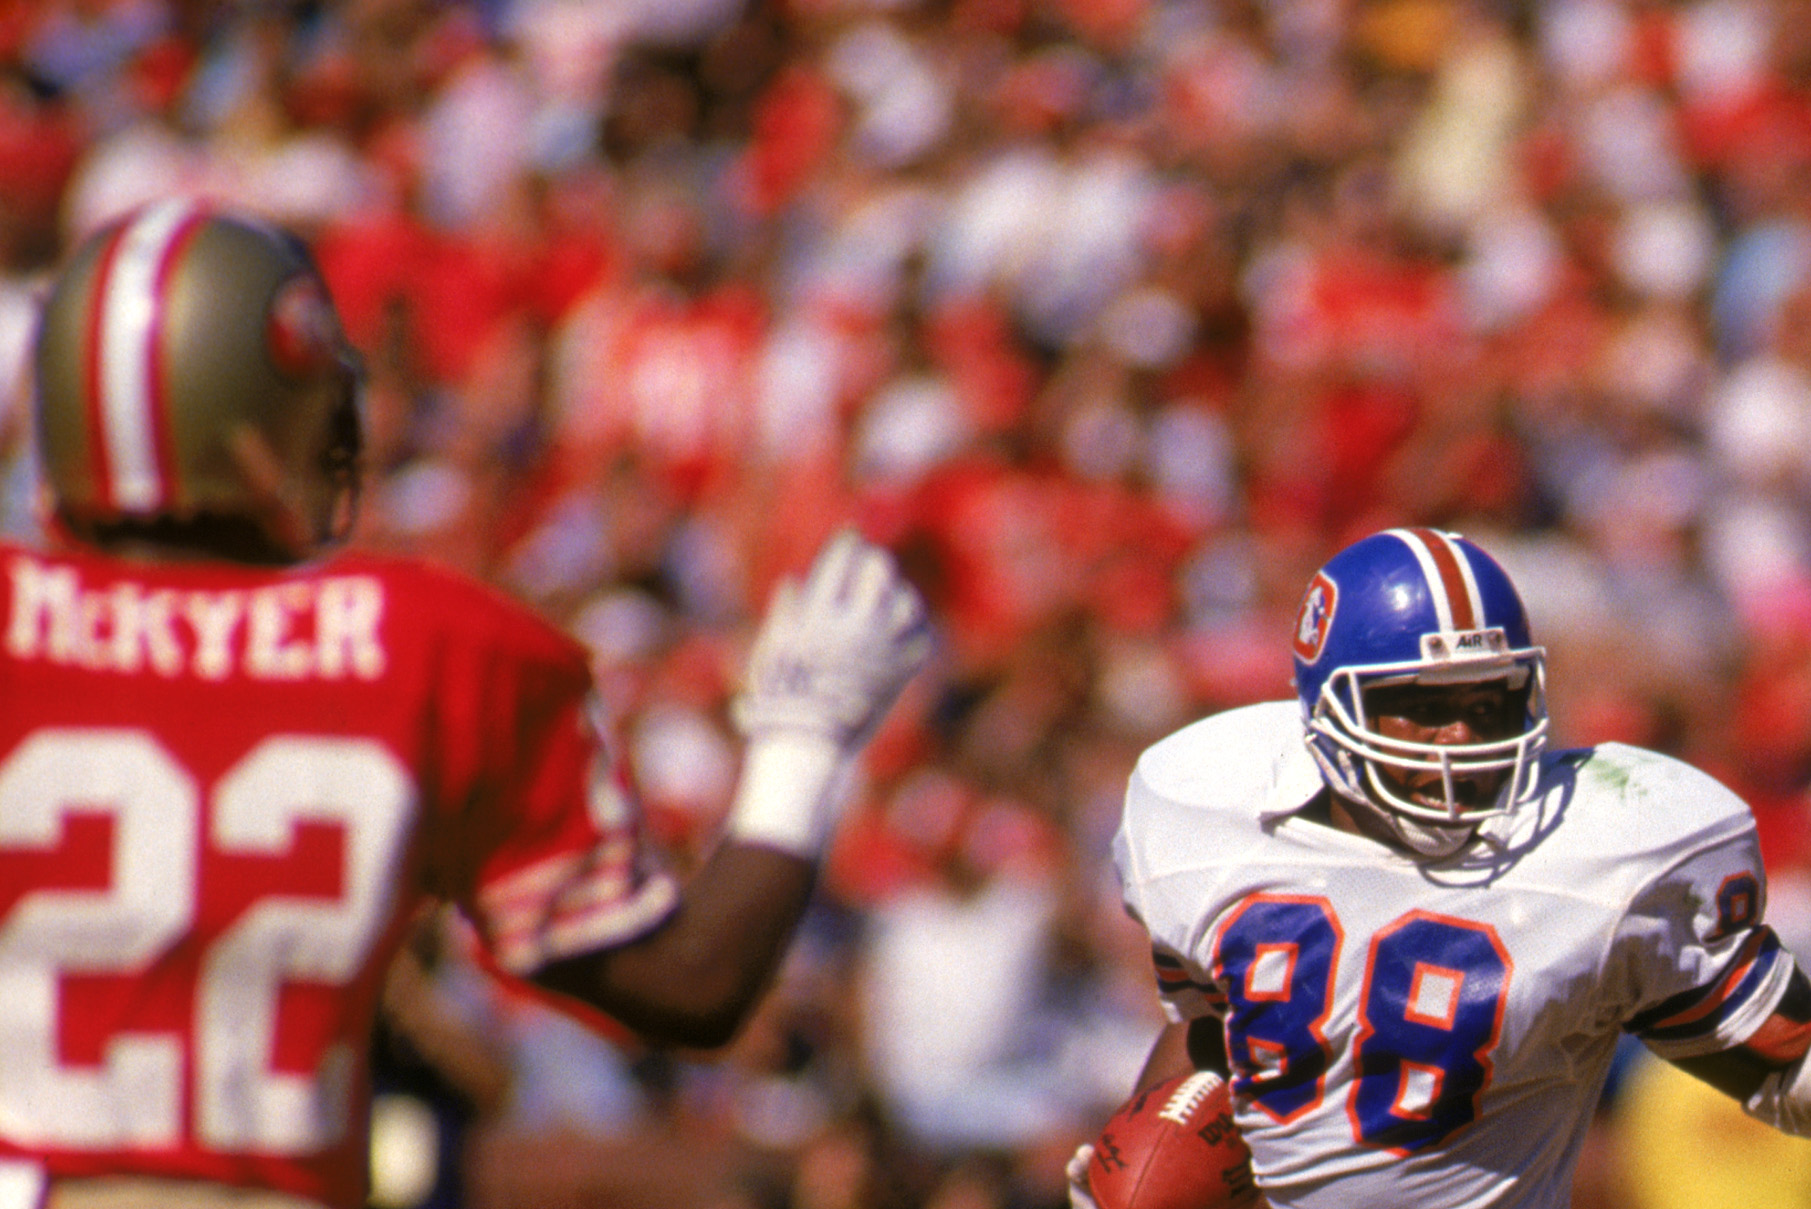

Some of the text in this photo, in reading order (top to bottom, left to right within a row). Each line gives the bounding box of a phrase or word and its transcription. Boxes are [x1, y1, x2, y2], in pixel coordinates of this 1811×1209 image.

[8, 555, 388, 681] McKYER
[0, 726, 418, 1154] 22
[1212, 892, 1515, 1159] 88
